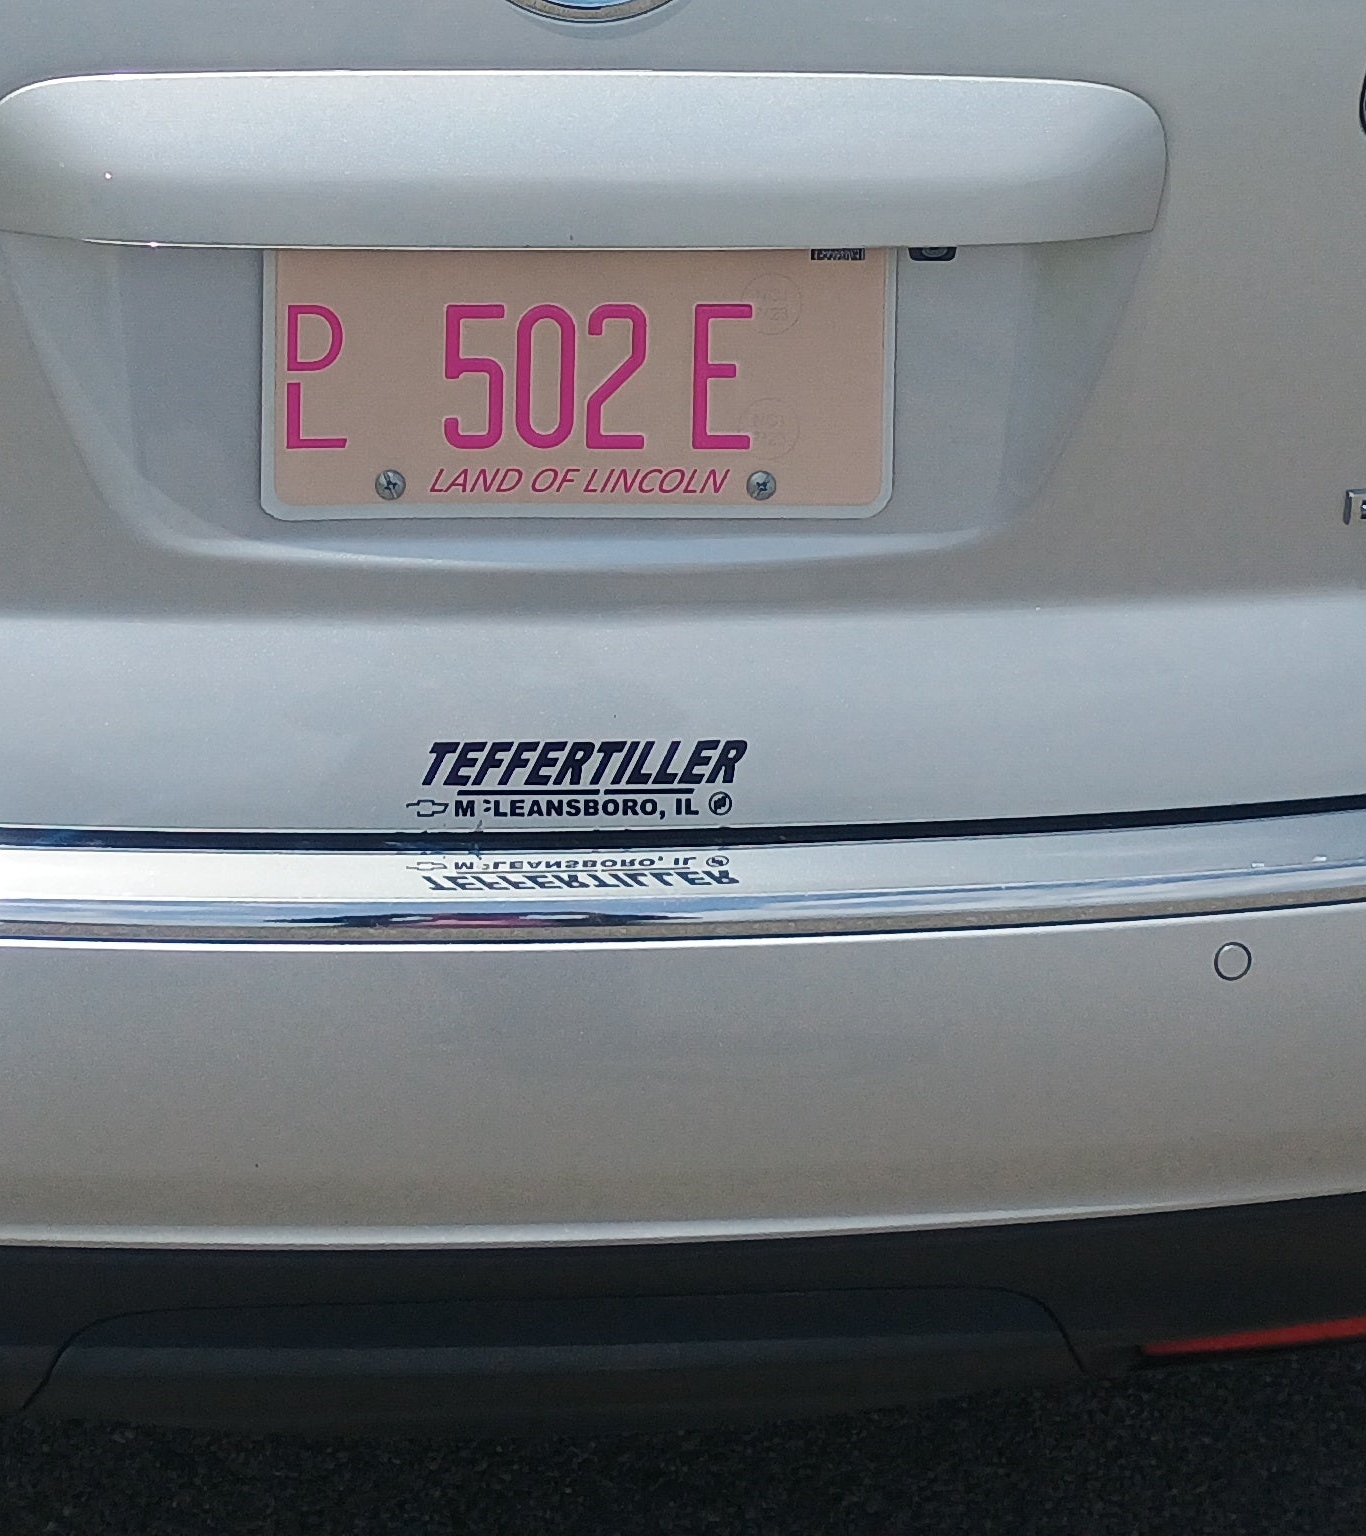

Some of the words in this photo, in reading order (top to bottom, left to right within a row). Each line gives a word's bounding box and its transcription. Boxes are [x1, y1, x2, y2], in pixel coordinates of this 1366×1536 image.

[443, 303, 647, 450] 502
[691, 303, 754, 450] E
[430, 468, 524, 495] LAND
[529, 467, 580, 495] OF
[582, 468, 730, 496] LINCOLN
[421, 739, 748, 787] TEFFERTILLER
[675, 797, 700, 816] IL
